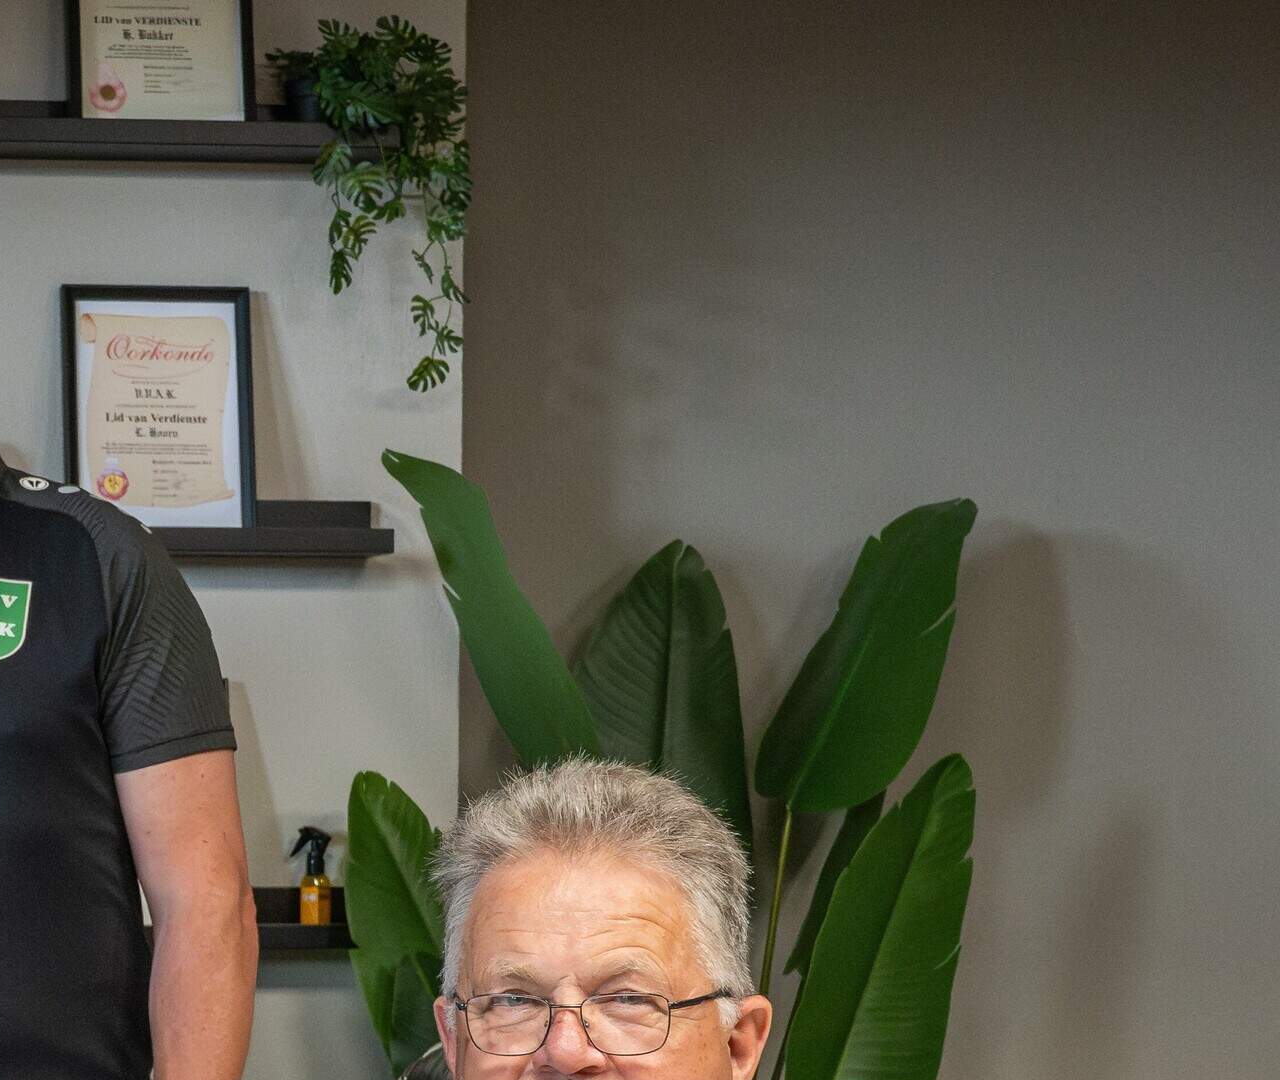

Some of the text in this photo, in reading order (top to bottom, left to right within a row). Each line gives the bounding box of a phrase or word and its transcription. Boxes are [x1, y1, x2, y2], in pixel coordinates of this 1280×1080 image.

[94, 16, 113, 25] LID
[135, 16, 202, 27] VERDIENSTE
[106, 332, 214, 363] Oorkonde
[106, 412, 208, 424] Lid van Verdienste
[0, 594, 18, 608] V
